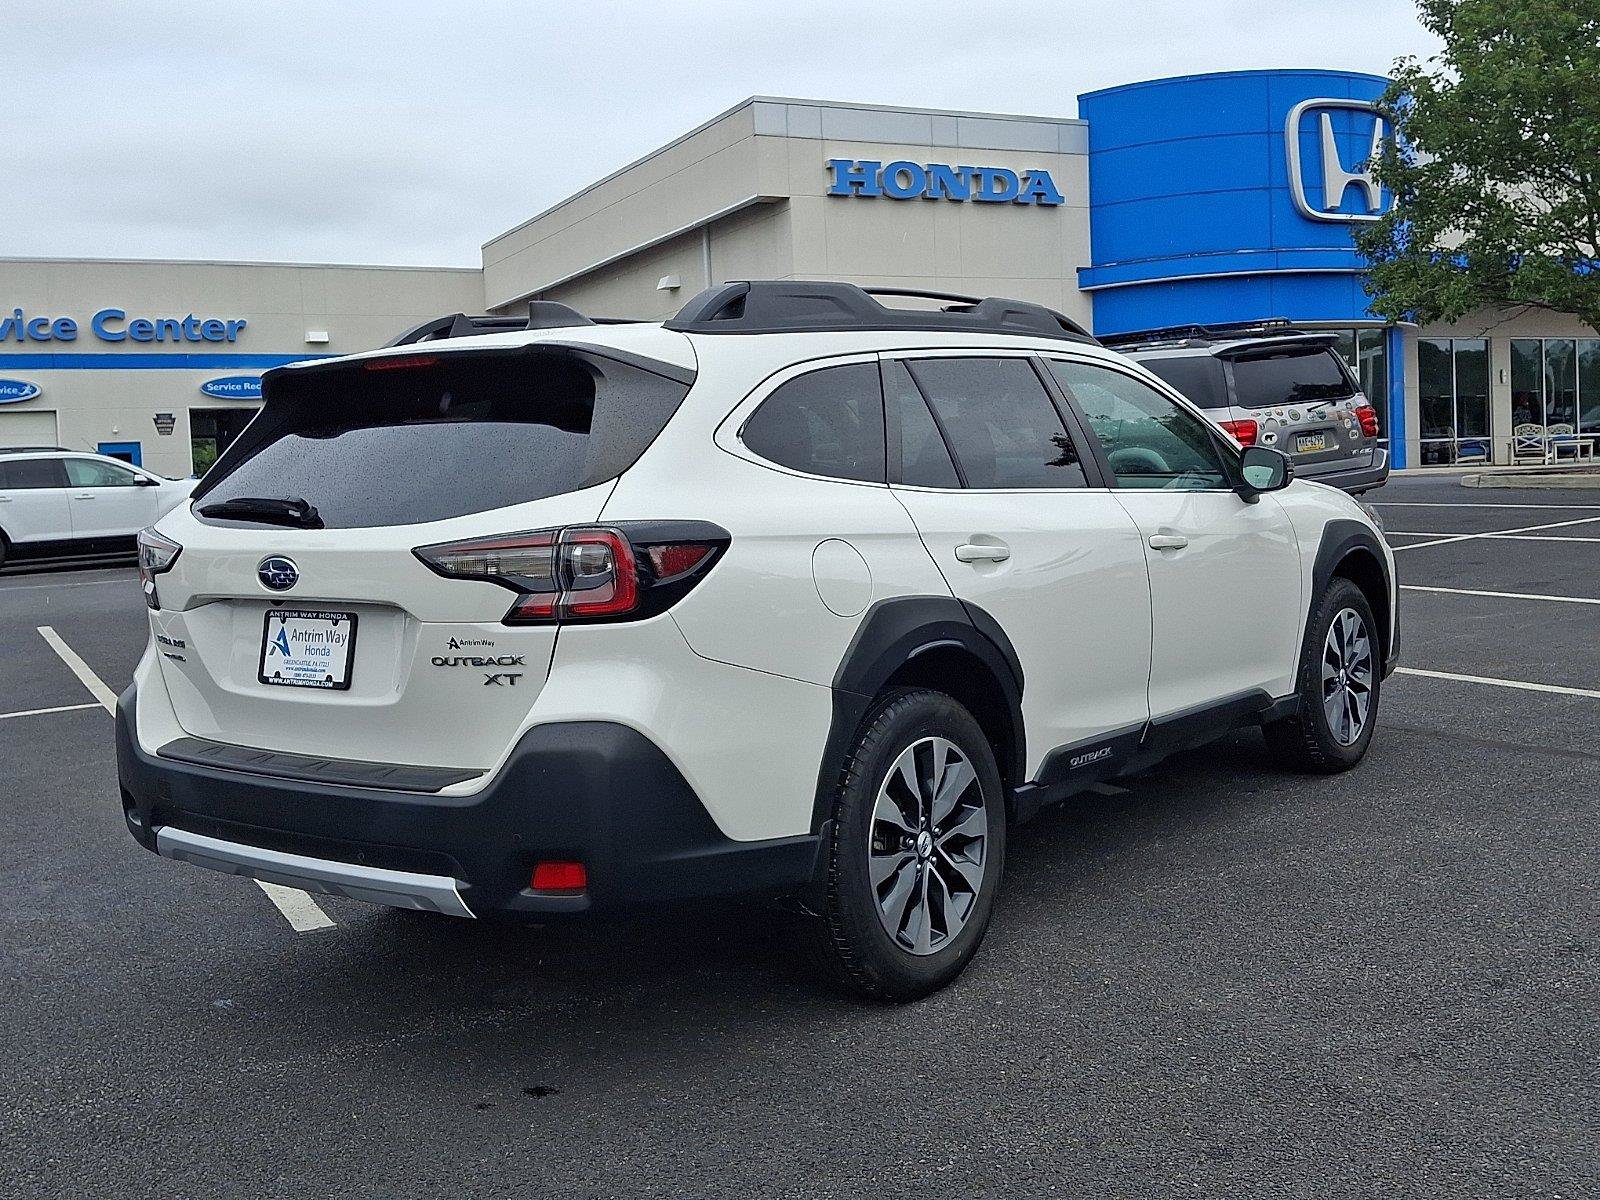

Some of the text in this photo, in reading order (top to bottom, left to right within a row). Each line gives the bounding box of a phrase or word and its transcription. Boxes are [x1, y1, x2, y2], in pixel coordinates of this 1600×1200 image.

[825, 158, 1065, 207] HONDA
[91, 308, 247, 343] Center
[206, 383, 242, 391] Service
[318, 612, 348, 620] HONDA
[291, 628, 348, 648] Antrim Way
[481, 639, 495, 648] Way
[304, 645, 331, 657] Honda
[430, 654, 527, 667] OUTBACK
[483, 673, 524, 686] XT
[1069, 746, 1113, 766] OUTBACK
